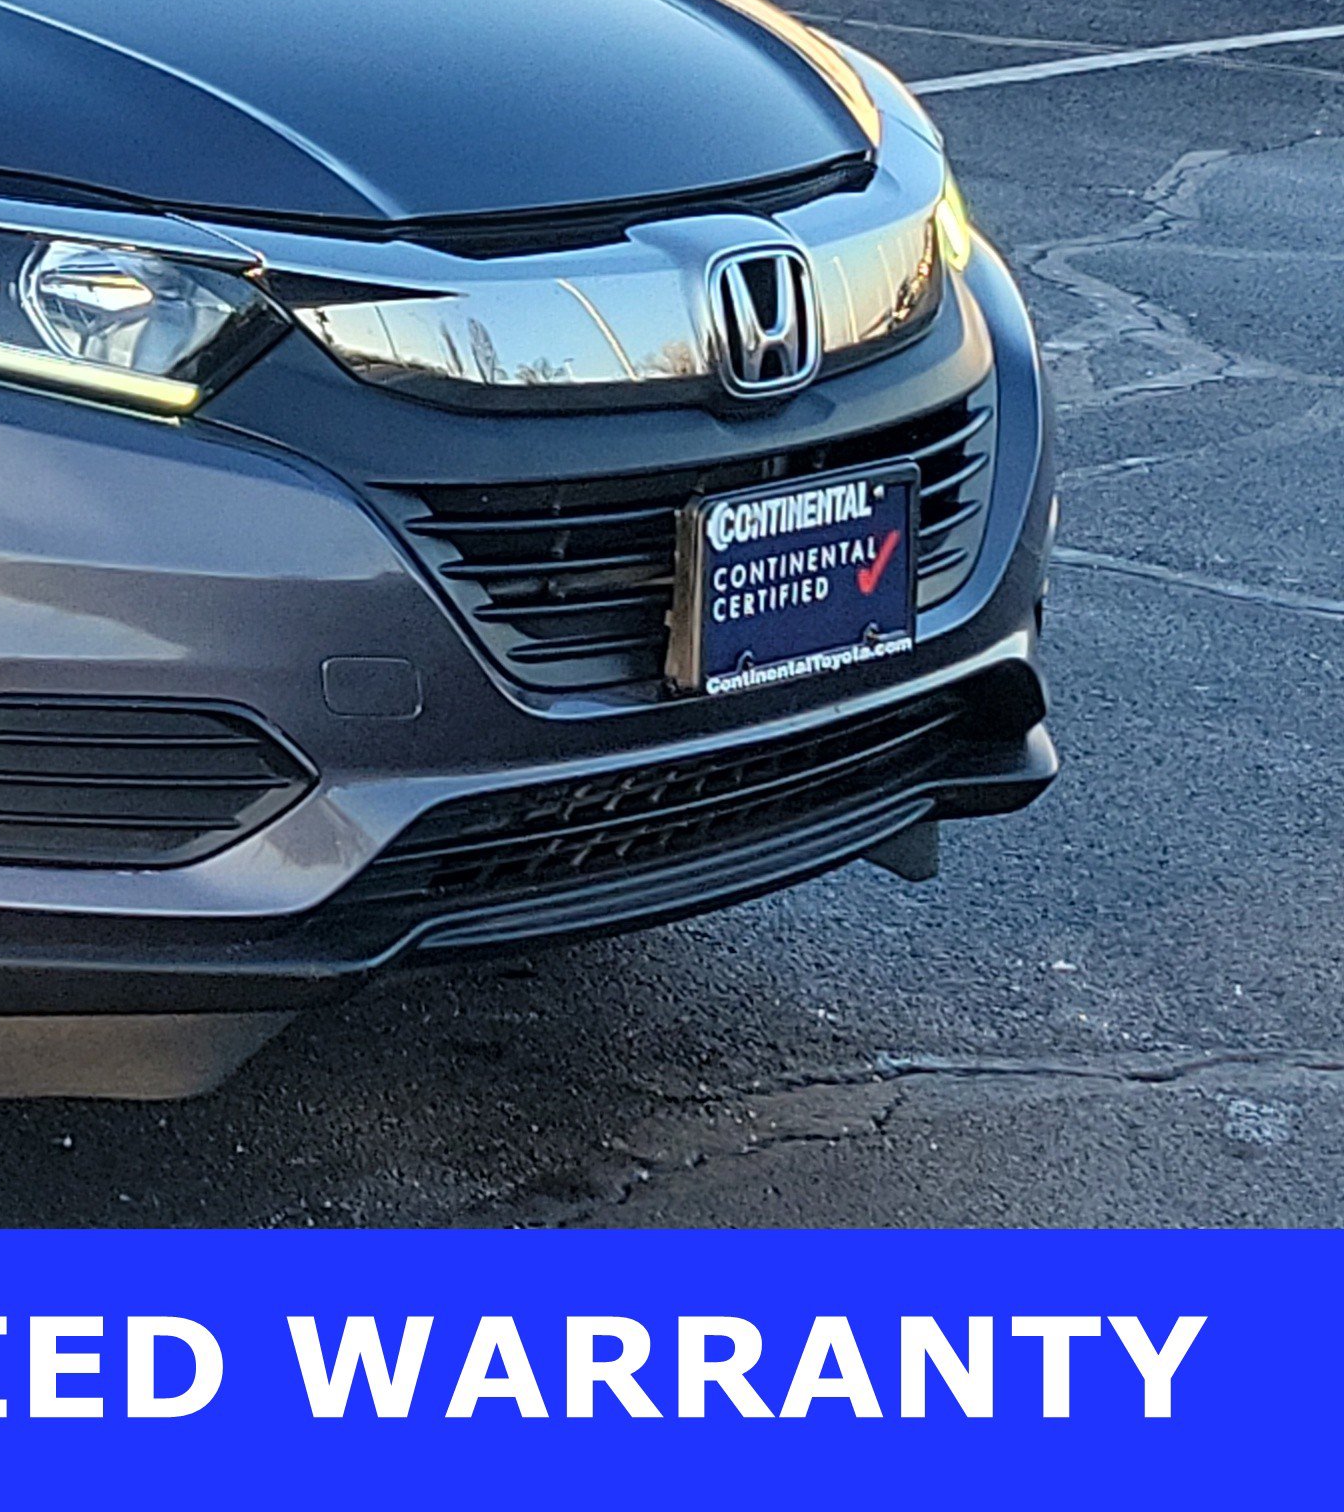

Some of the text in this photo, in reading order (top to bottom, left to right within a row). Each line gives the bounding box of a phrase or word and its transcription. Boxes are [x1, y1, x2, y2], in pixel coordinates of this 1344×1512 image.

[707, 480, 872, 551] CONTINENTAL
[713, 536, 877, 593] CONTINENTAL
[712, 576, 829, 622] CERTIFIED
